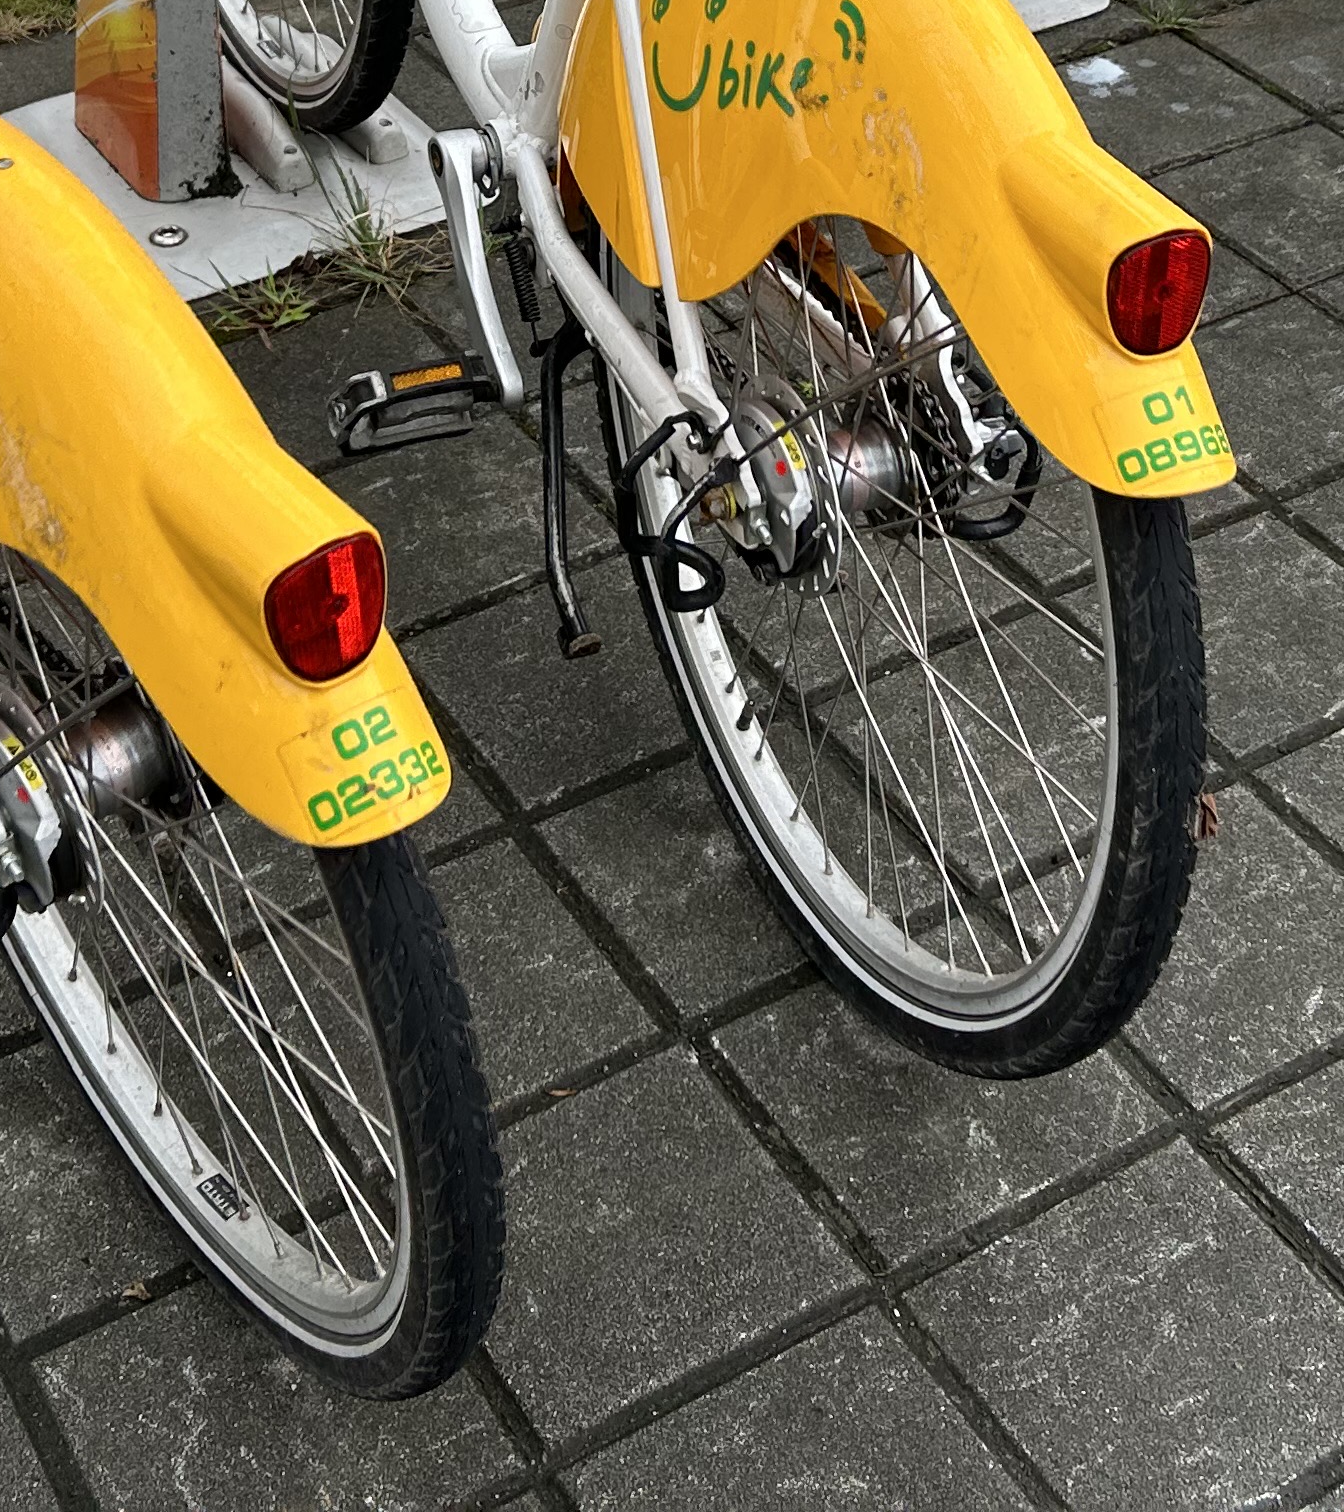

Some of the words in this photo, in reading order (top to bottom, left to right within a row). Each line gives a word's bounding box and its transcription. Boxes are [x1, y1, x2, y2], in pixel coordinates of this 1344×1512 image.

[1141, 385, 1196, 426] 01
[1116, 423, 1232, 483] 08968
[330, 704, 399, 761] 02
[307, 739, 445, 833] 02332
